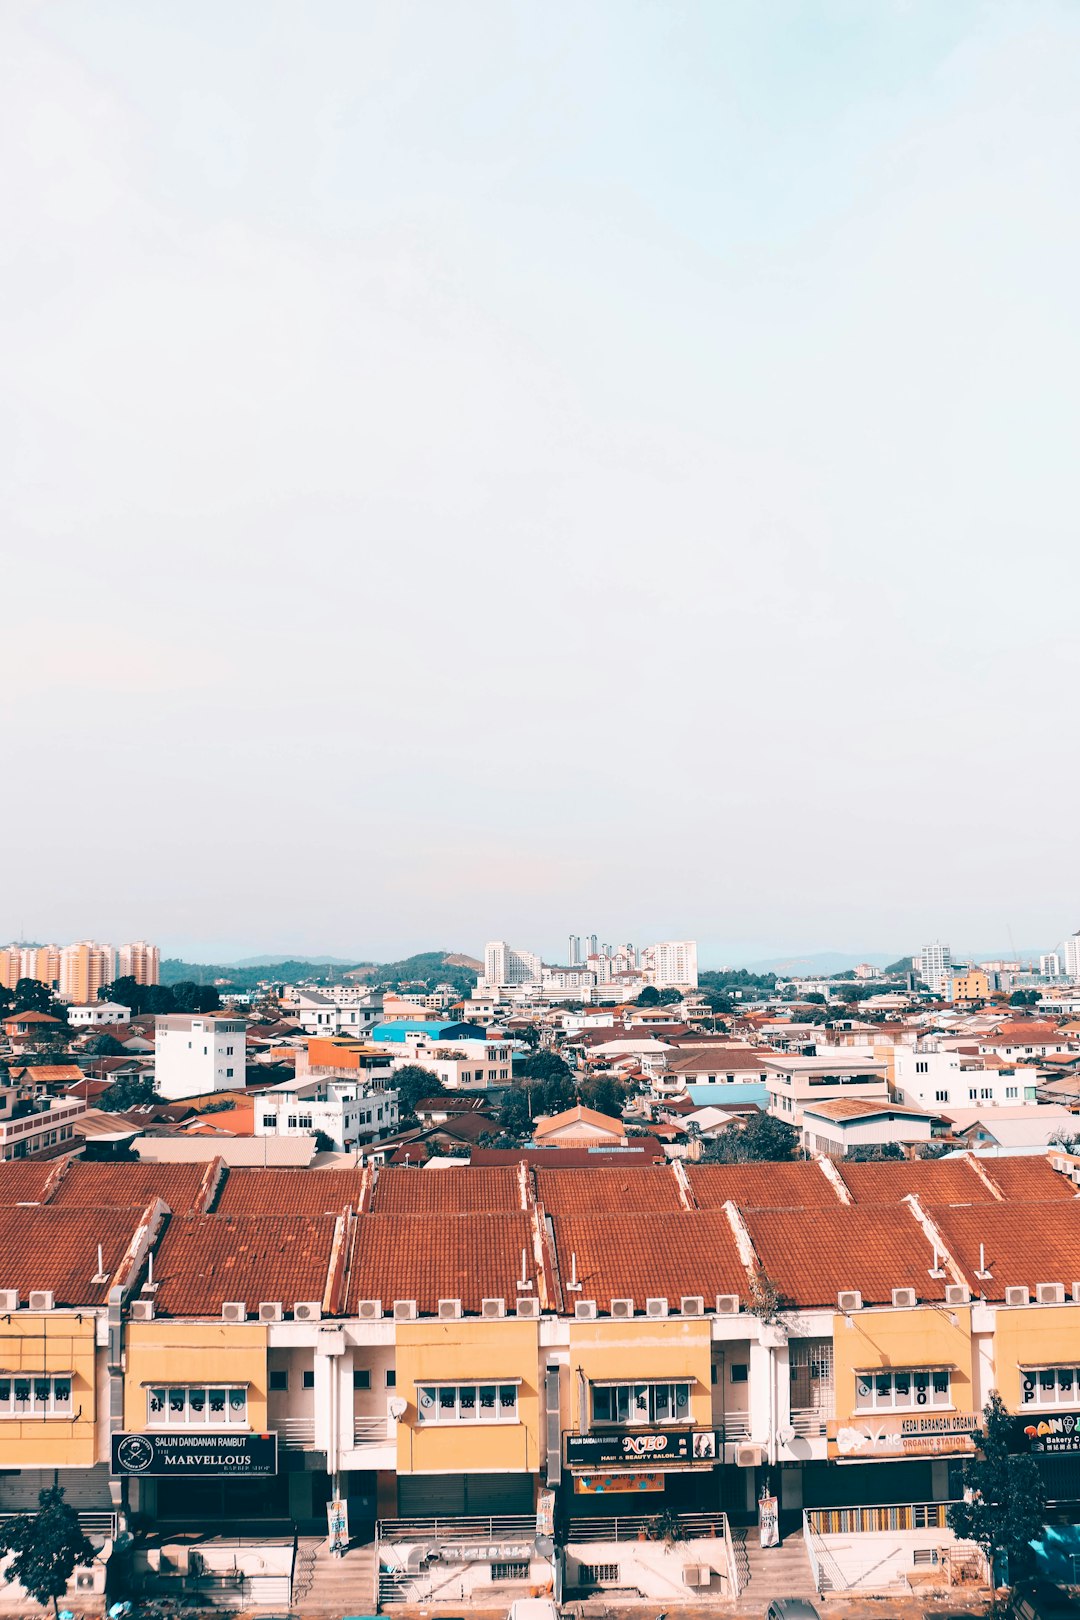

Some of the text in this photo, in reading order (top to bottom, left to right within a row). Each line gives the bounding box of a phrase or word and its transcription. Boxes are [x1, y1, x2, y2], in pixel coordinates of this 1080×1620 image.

[902, 1416, 978, 1432] KEDAI BARANGAN ORGANIK
[155, 1437, 247, 1447] SALUN DANDANAN RAMBUT
[622, 1435, 668, 1454] NEO
[903, 1436, 966, 1448] ORGANIC STATION
[164, 1456, 251, 1465] MARVELLOUS
